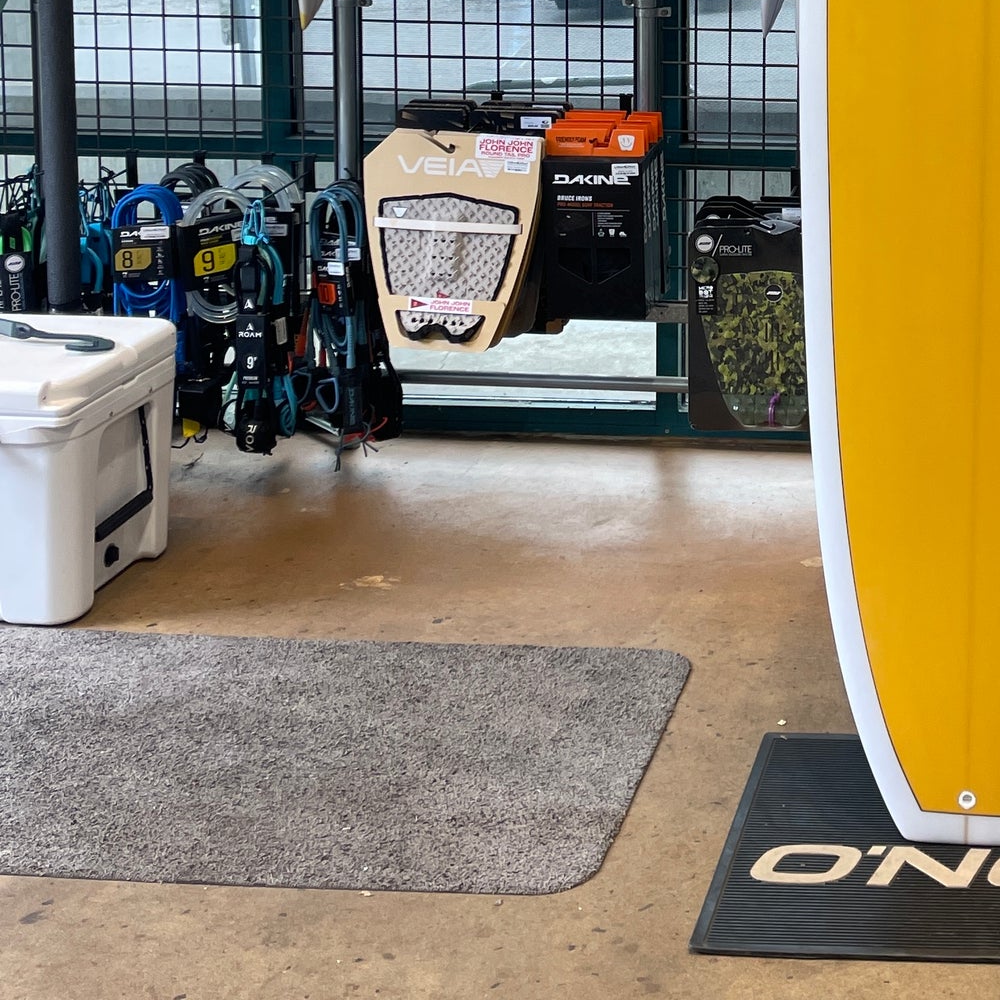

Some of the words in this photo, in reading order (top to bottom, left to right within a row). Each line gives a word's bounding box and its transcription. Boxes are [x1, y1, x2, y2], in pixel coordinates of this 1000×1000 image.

[479, 144, 533, 154] FLORENCE
[397, 154, 485, 178] VEIA
[552, 174, 631, 186] DAKINE
[122, 250, 133, 269] 8
[201, 250, 215, 272] 9
[245, 424, 258, 453] ROA
